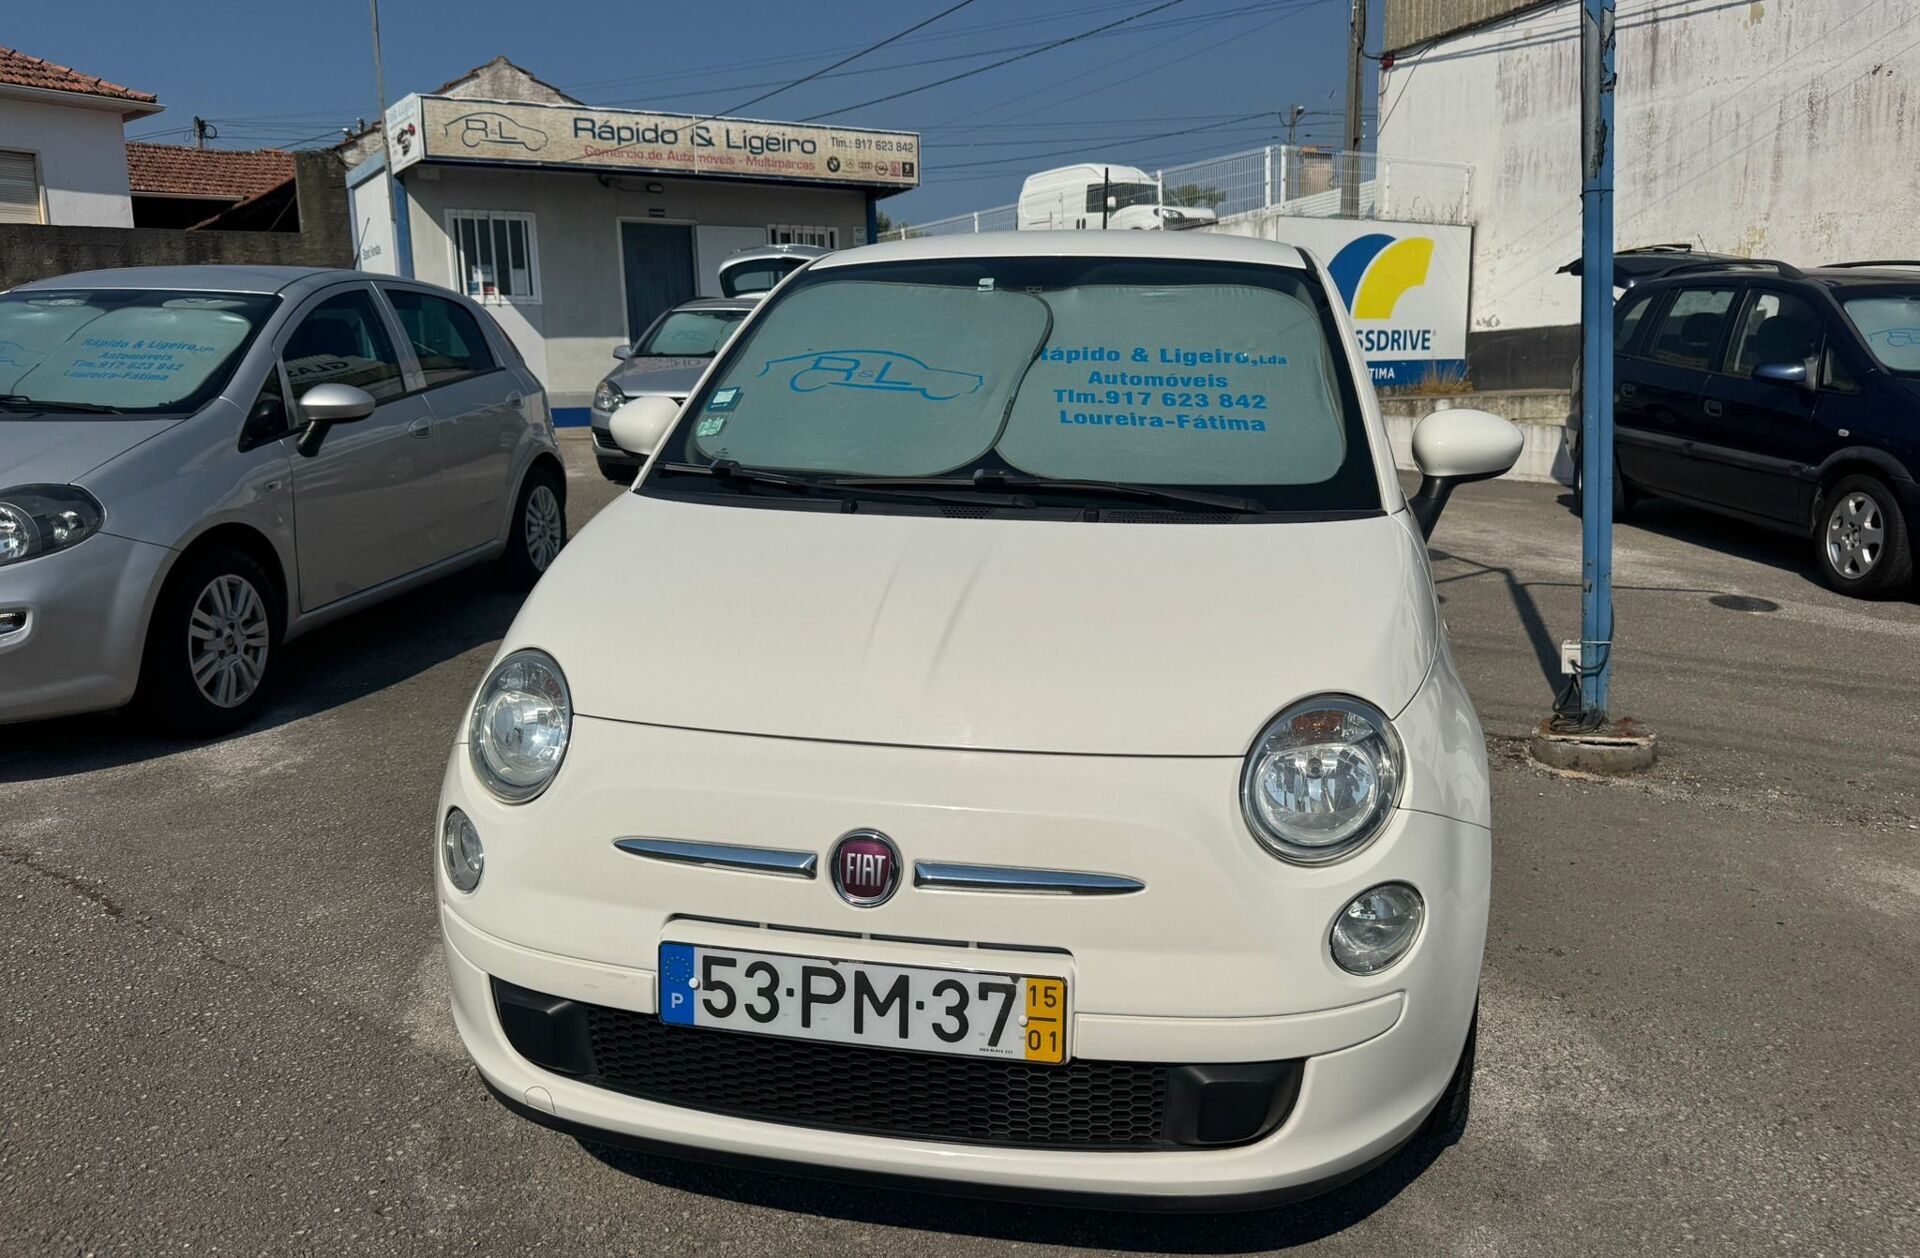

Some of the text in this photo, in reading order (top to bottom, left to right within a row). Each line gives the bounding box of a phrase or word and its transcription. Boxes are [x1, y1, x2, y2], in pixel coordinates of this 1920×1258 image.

[573, 117, 817, 155] Rápido & Ligeiro
[855, 138, 872, 150] 917
[875, 139, 893, 151] 623
[896, 140, 914, 153] 842
[648, 150, 663, 160] de
[745, 155, 816, 171] Multimarcas
[132, 340, 145, 349] &
[1130, 347, 1149, 363] &
[127, 361, 155, 371] 623
[156, 361, 184, 371] 842
[1088, 371, 1229, 388] Automóveis
[1162, 392, 1210, 408] 623
[1219, 394, 1268, 409] 842
[1060, 410, 1266, 432] Loureira-Fátima
[845, 852, 886, 887] FIAT
[671, 992, 685, 1009] P
[1029, 985, 1057, 1008] 15
[1028, 1029, 1057, 1052] 01
